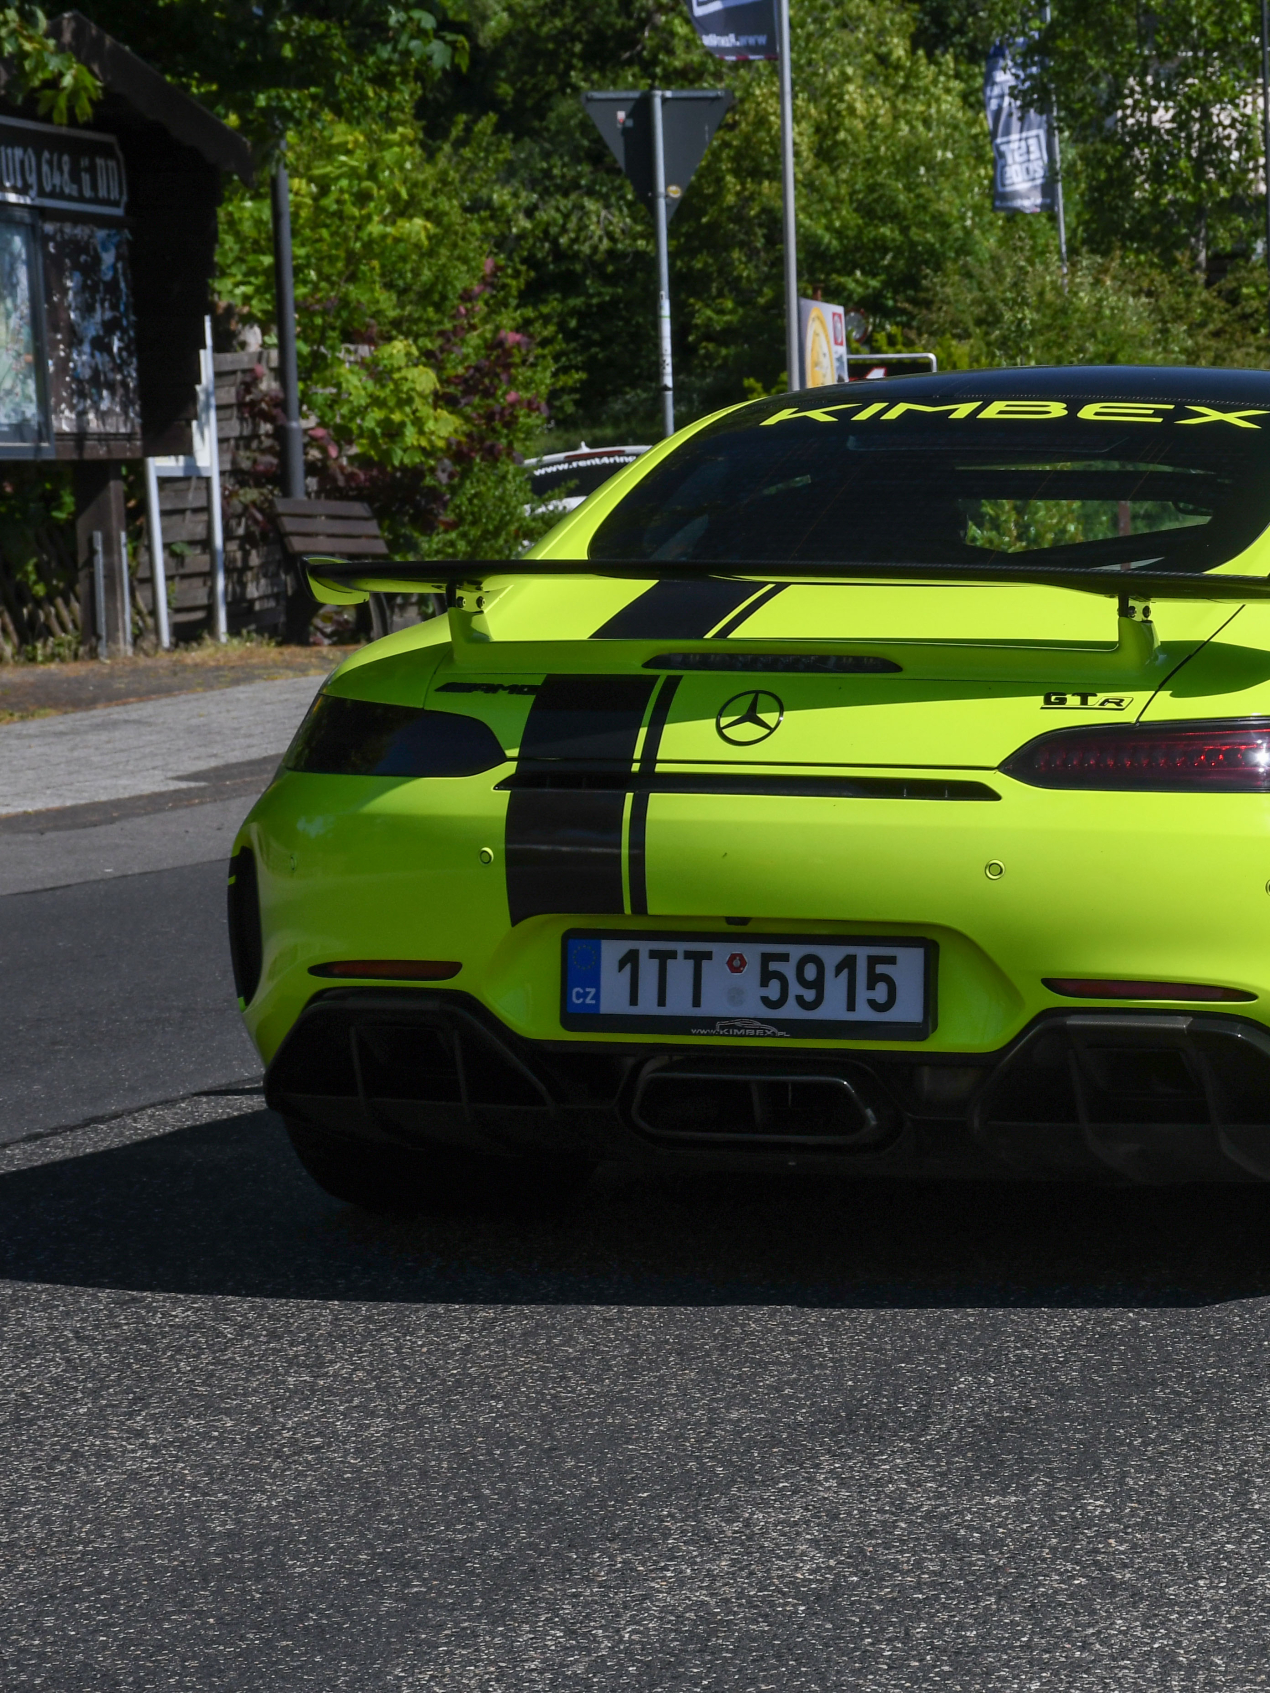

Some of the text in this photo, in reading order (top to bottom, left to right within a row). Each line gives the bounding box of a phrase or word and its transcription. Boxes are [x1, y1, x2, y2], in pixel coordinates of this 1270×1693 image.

[571, 987, 596, 1005] CZ
[618, 948, 897, 1014] 1TT 5915
